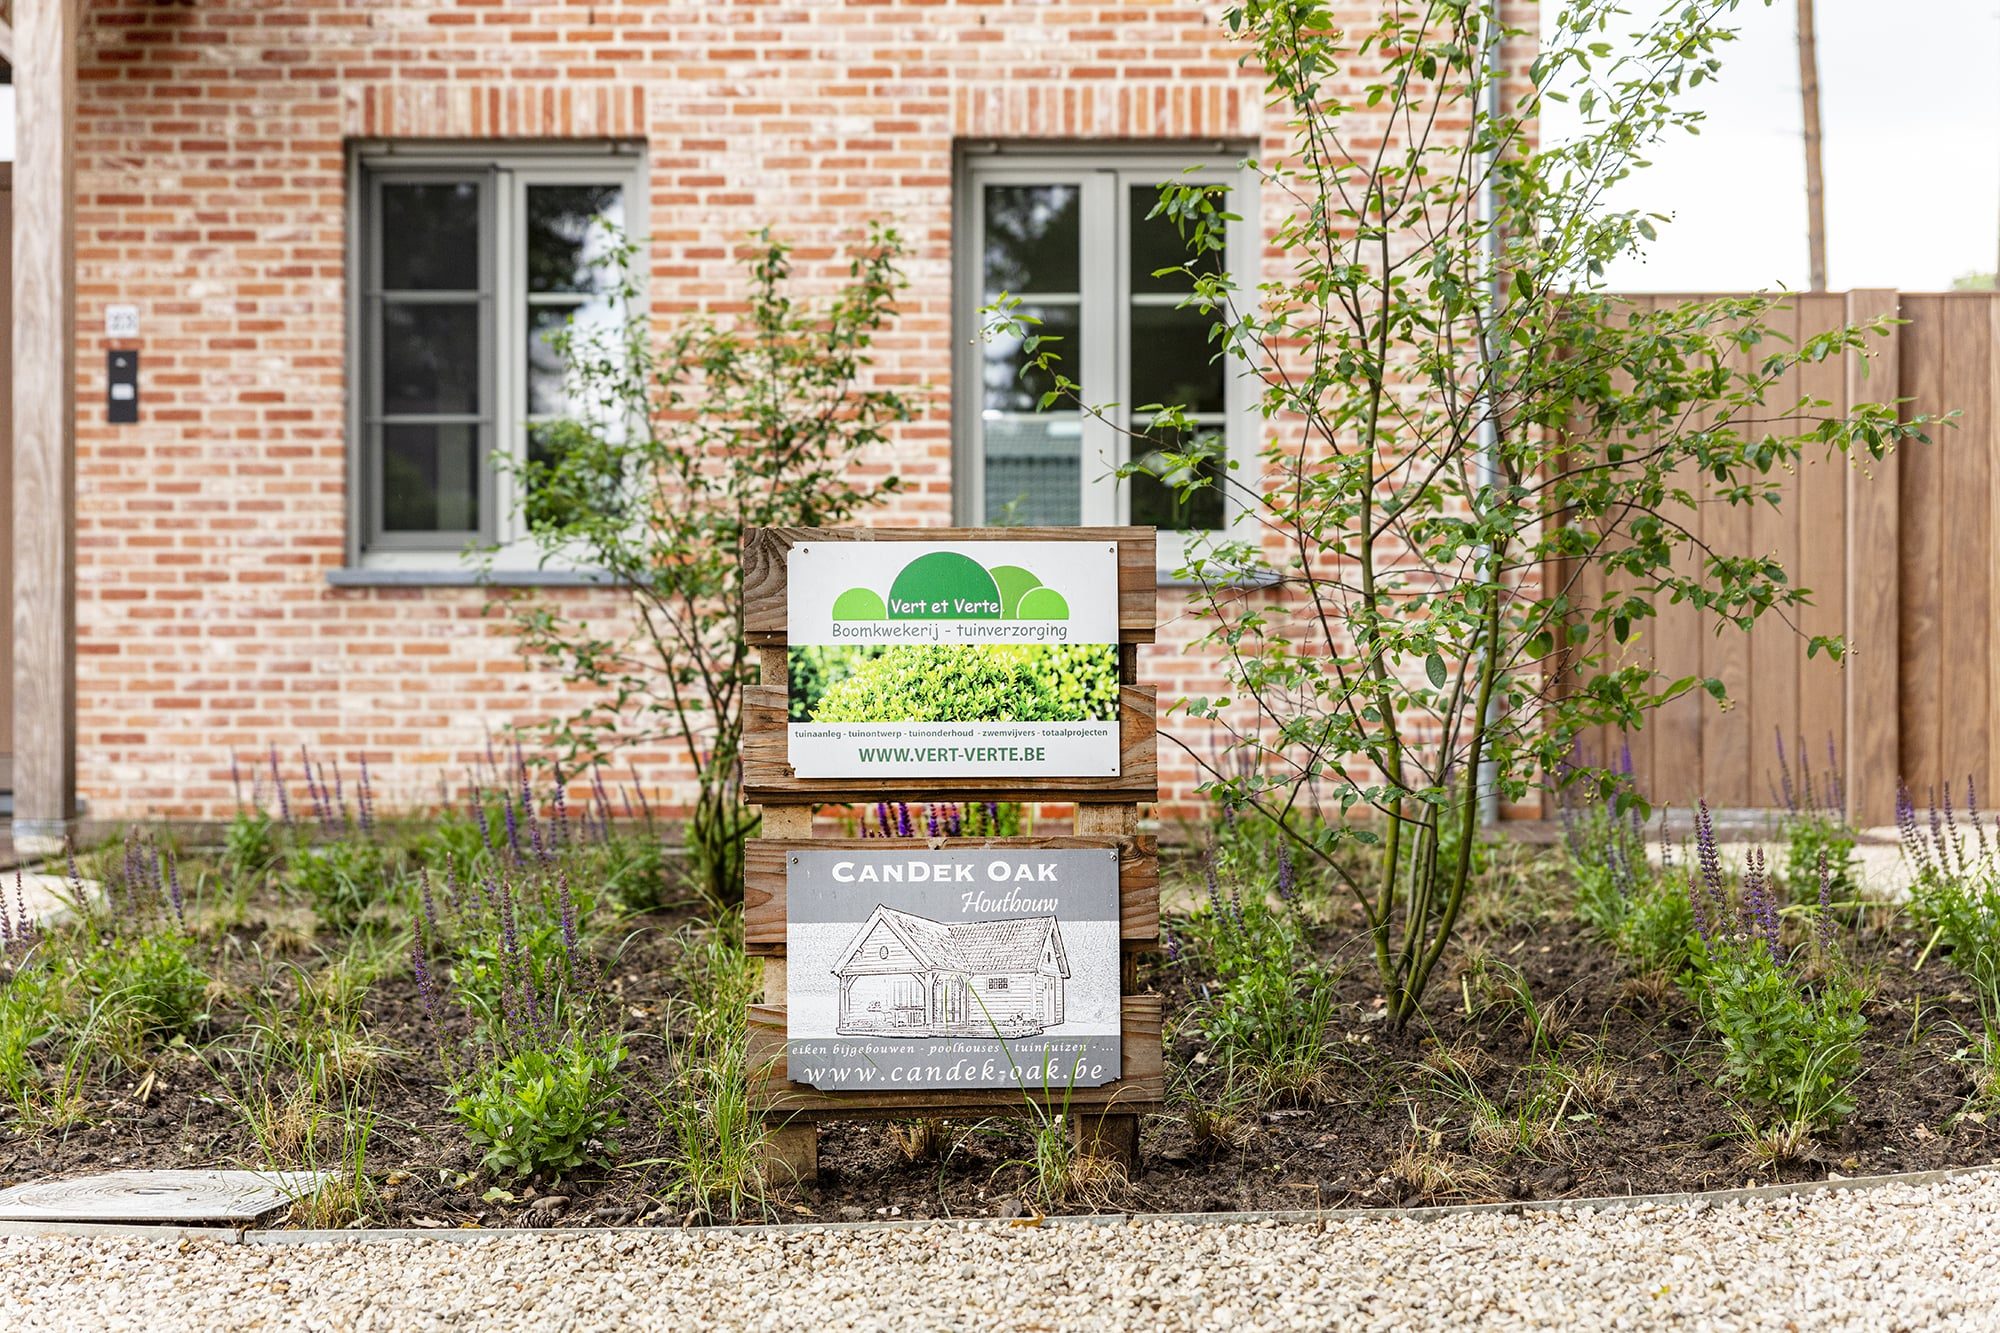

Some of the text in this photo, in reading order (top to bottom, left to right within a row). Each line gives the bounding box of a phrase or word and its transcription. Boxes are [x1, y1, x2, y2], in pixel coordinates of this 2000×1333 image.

[891, 599, 999, 614] Vert et Verte
[832, 623, 939, 641] Boomkwekerij
[957, 623, 1067, 641] tuinverzorging
[795, 730, 841, 739] tuinaanleg
[848, 730, 902, 739] tuinontwerp
[909, 729, 974, 738] tuinonderhoud
[982, 729, 1035, 738] zwemvijvers
[1042, 728, 1108, 738] totaalprojecten
[858, 747, 1046, 763] WWW.VERT-VERTE.BE
[961, 887, 1058, 913] Houtbouw
[792, 1045, 827, 1055] eiken
[832, 1043, 914, 1057] bijgebouwen
[927, 1042, 1000, 1056] poolhouses
[803, 1057, 1102, 1081] www.candek-oak.be
